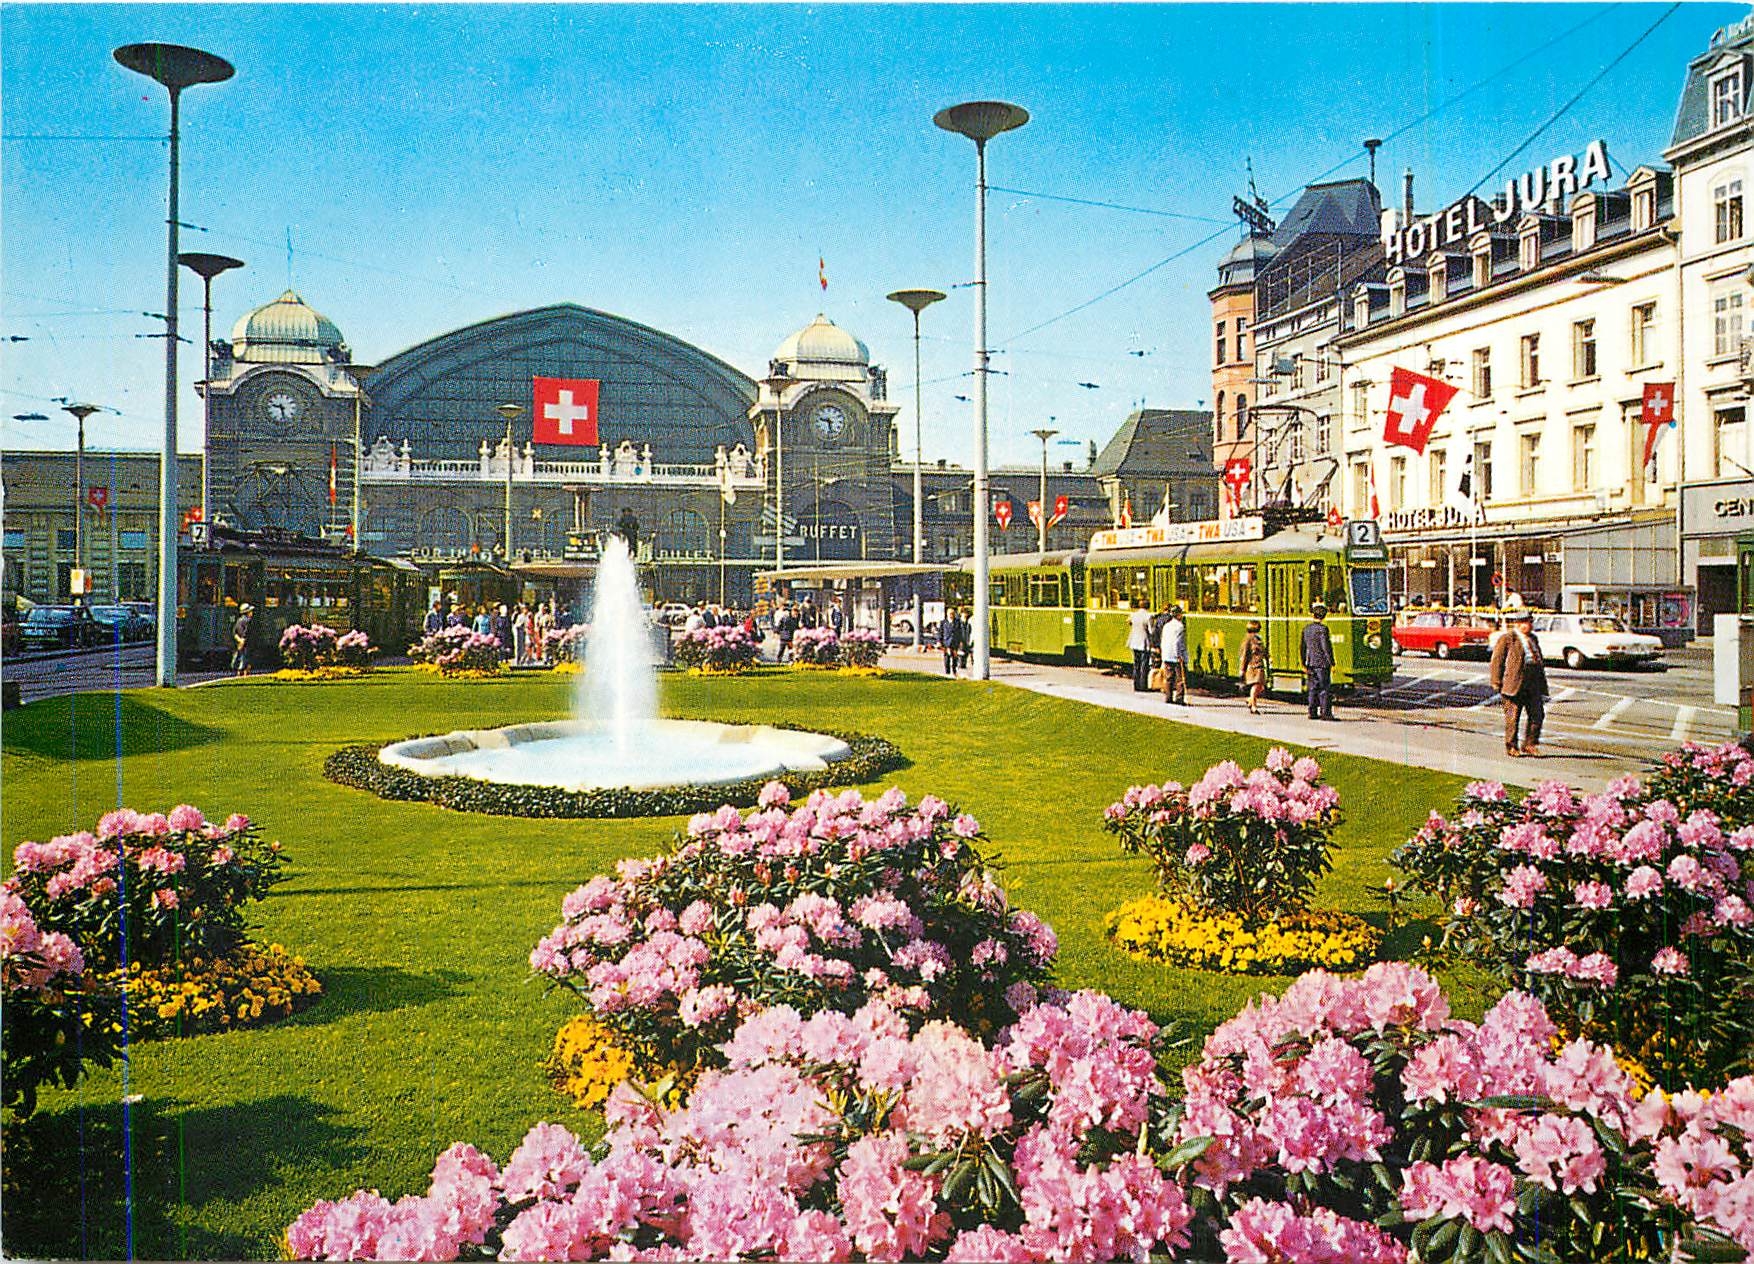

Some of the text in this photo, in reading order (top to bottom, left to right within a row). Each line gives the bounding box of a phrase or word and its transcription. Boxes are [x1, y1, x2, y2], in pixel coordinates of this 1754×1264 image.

[1385, 139, 1612, 265] HOTEL JURA
[1386, 508, 1439, 530] HOTEL
[1102, 532, 1117, 545] TWA
[1146, 528, 1164, 542] TWA
[1200, 523, 1221, 538] TWA
[1224, 520, 1246, 537] USA
[1357, 524, 1370, 542] 2
